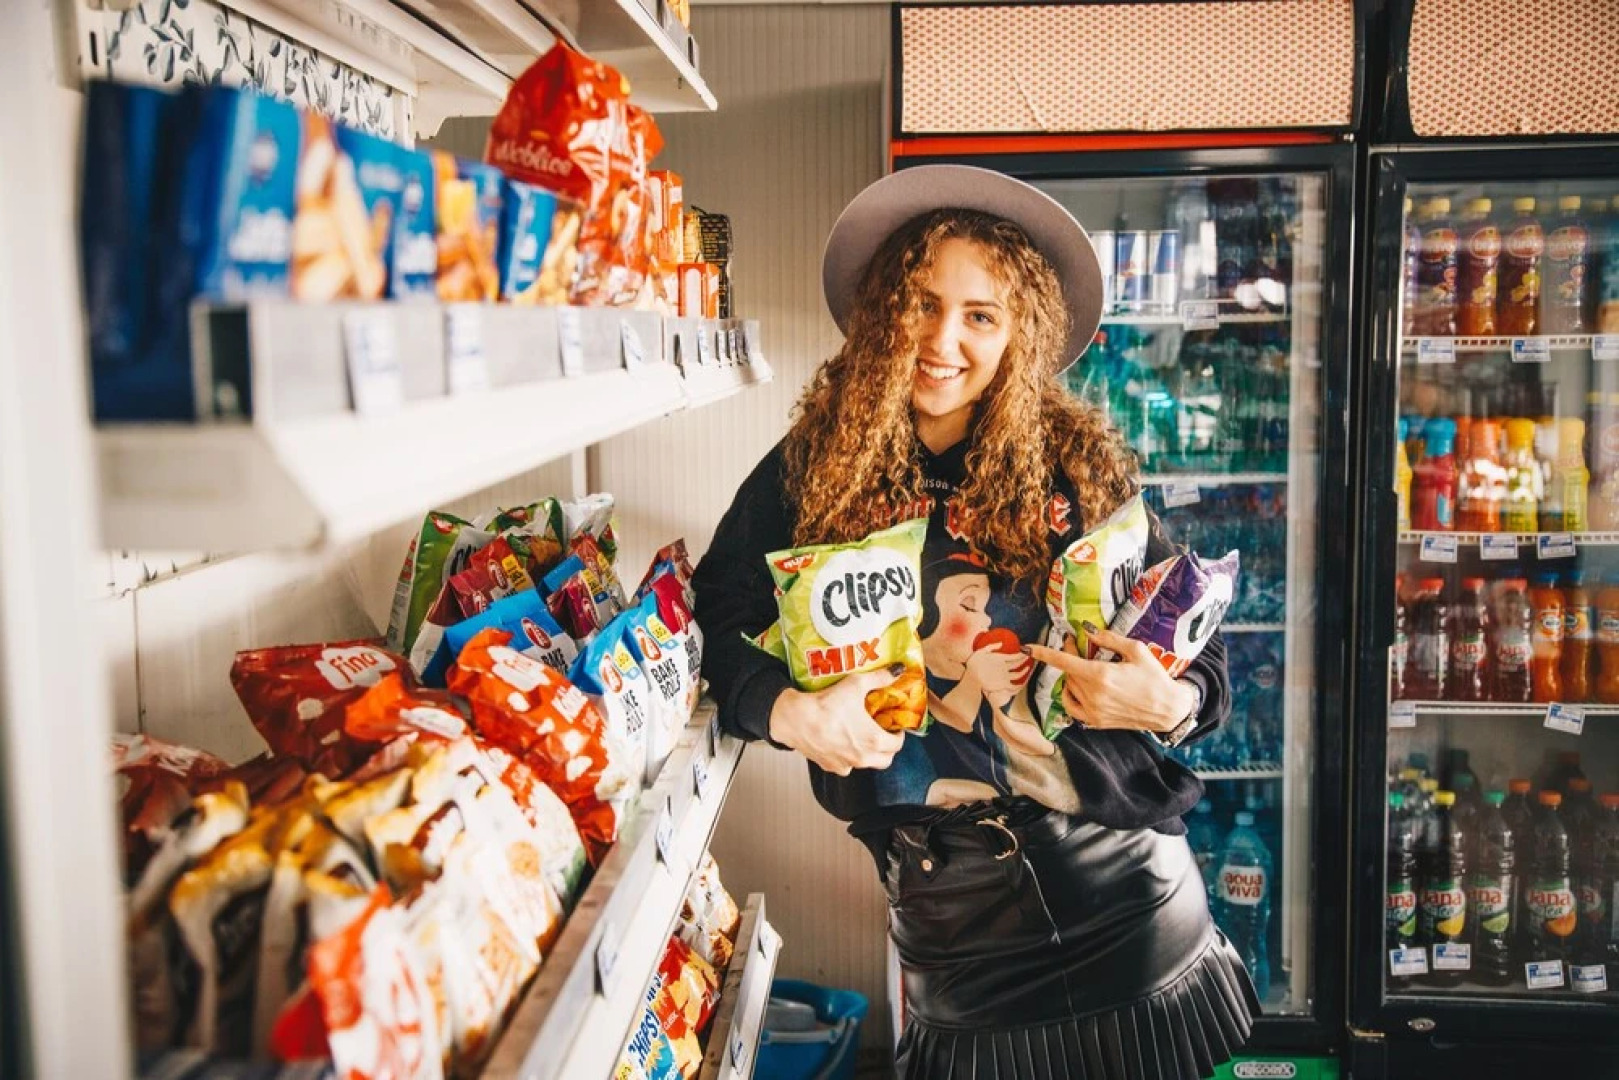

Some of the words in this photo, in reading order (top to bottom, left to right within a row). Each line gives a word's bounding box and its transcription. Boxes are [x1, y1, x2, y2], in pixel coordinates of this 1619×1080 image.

[821, 566, 917, 628] Clipsy
[329, 653, 379, 684] fina
[806, 637, 881, 678] MIX
[1227, 884, 1261, 897] viva
